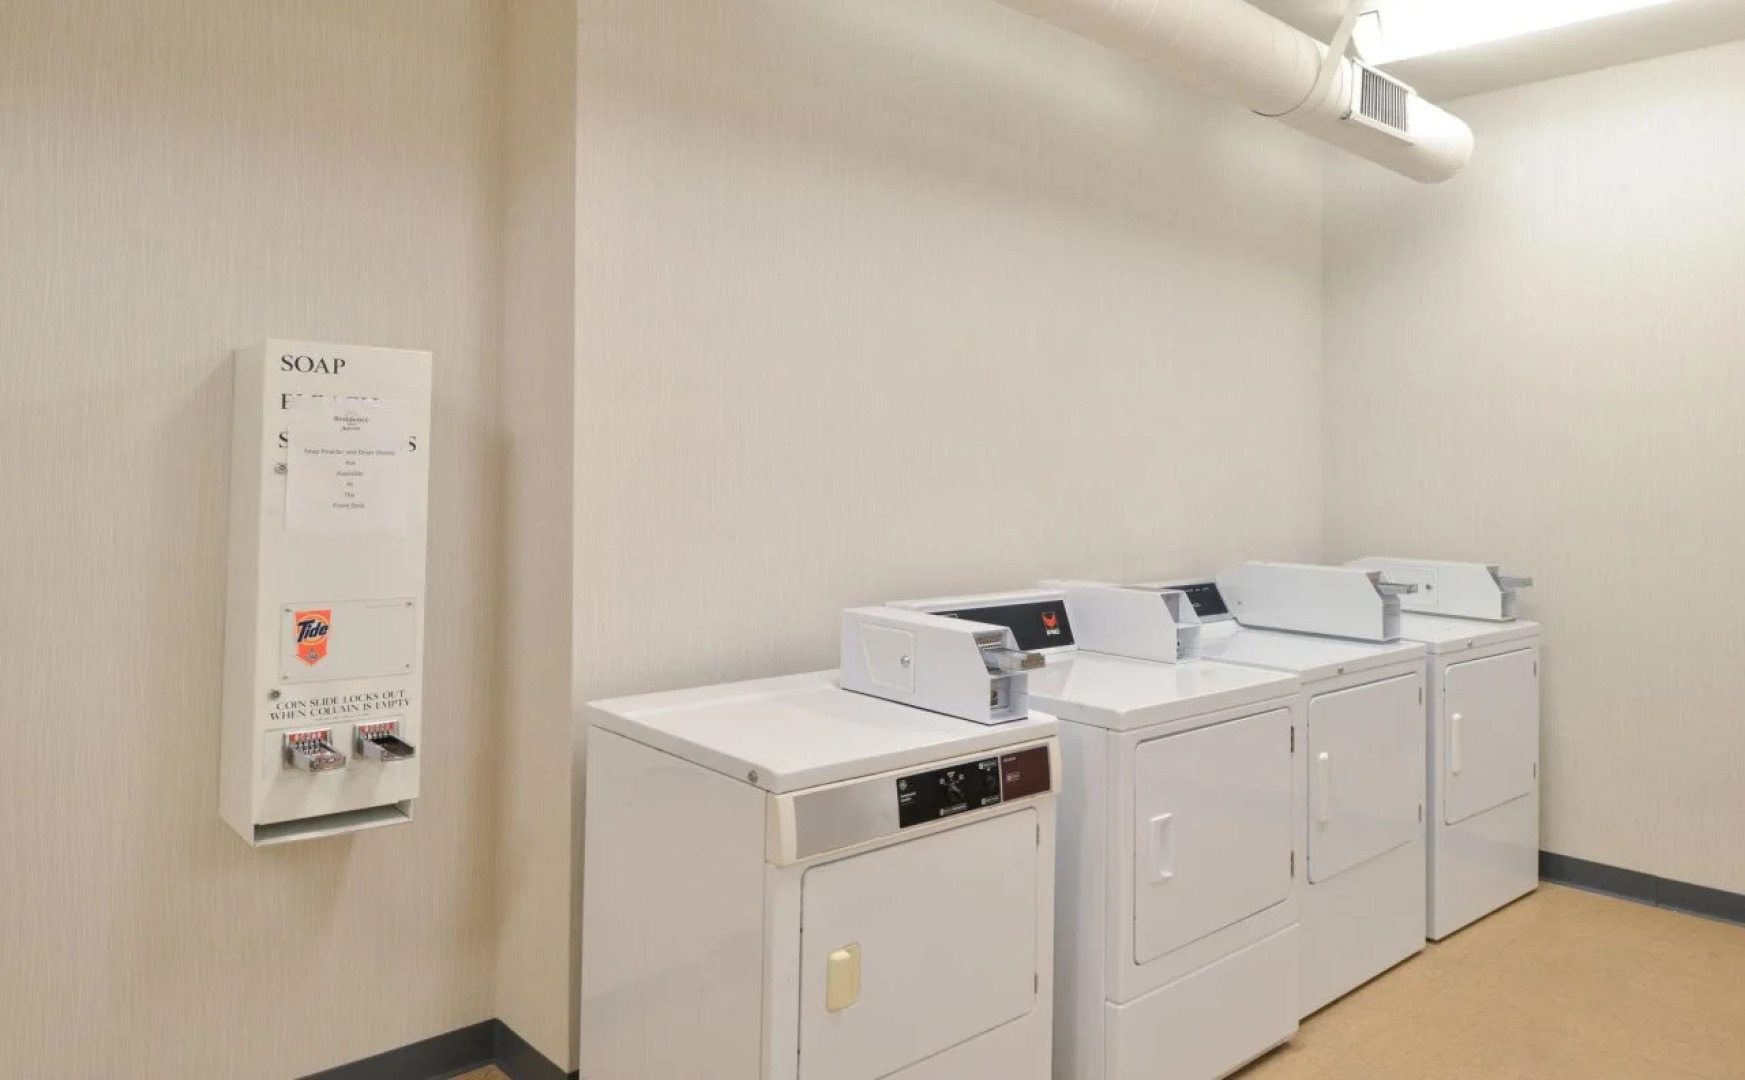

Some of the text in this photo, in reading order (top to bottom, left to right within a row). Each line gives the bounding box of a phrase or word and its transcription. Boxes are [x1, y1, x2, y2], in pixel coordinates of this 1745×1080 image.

[281, 355, 346, 374] SOAP
[297, 619, 329, 643] Tide
[270, 710, 306, 720] WHEN
[363, 702, 372, 710] IS
[375, 698, 410, 710] EMPTY
[276, 689, 405, 710] COIN SLIDE LOCKS OUT
